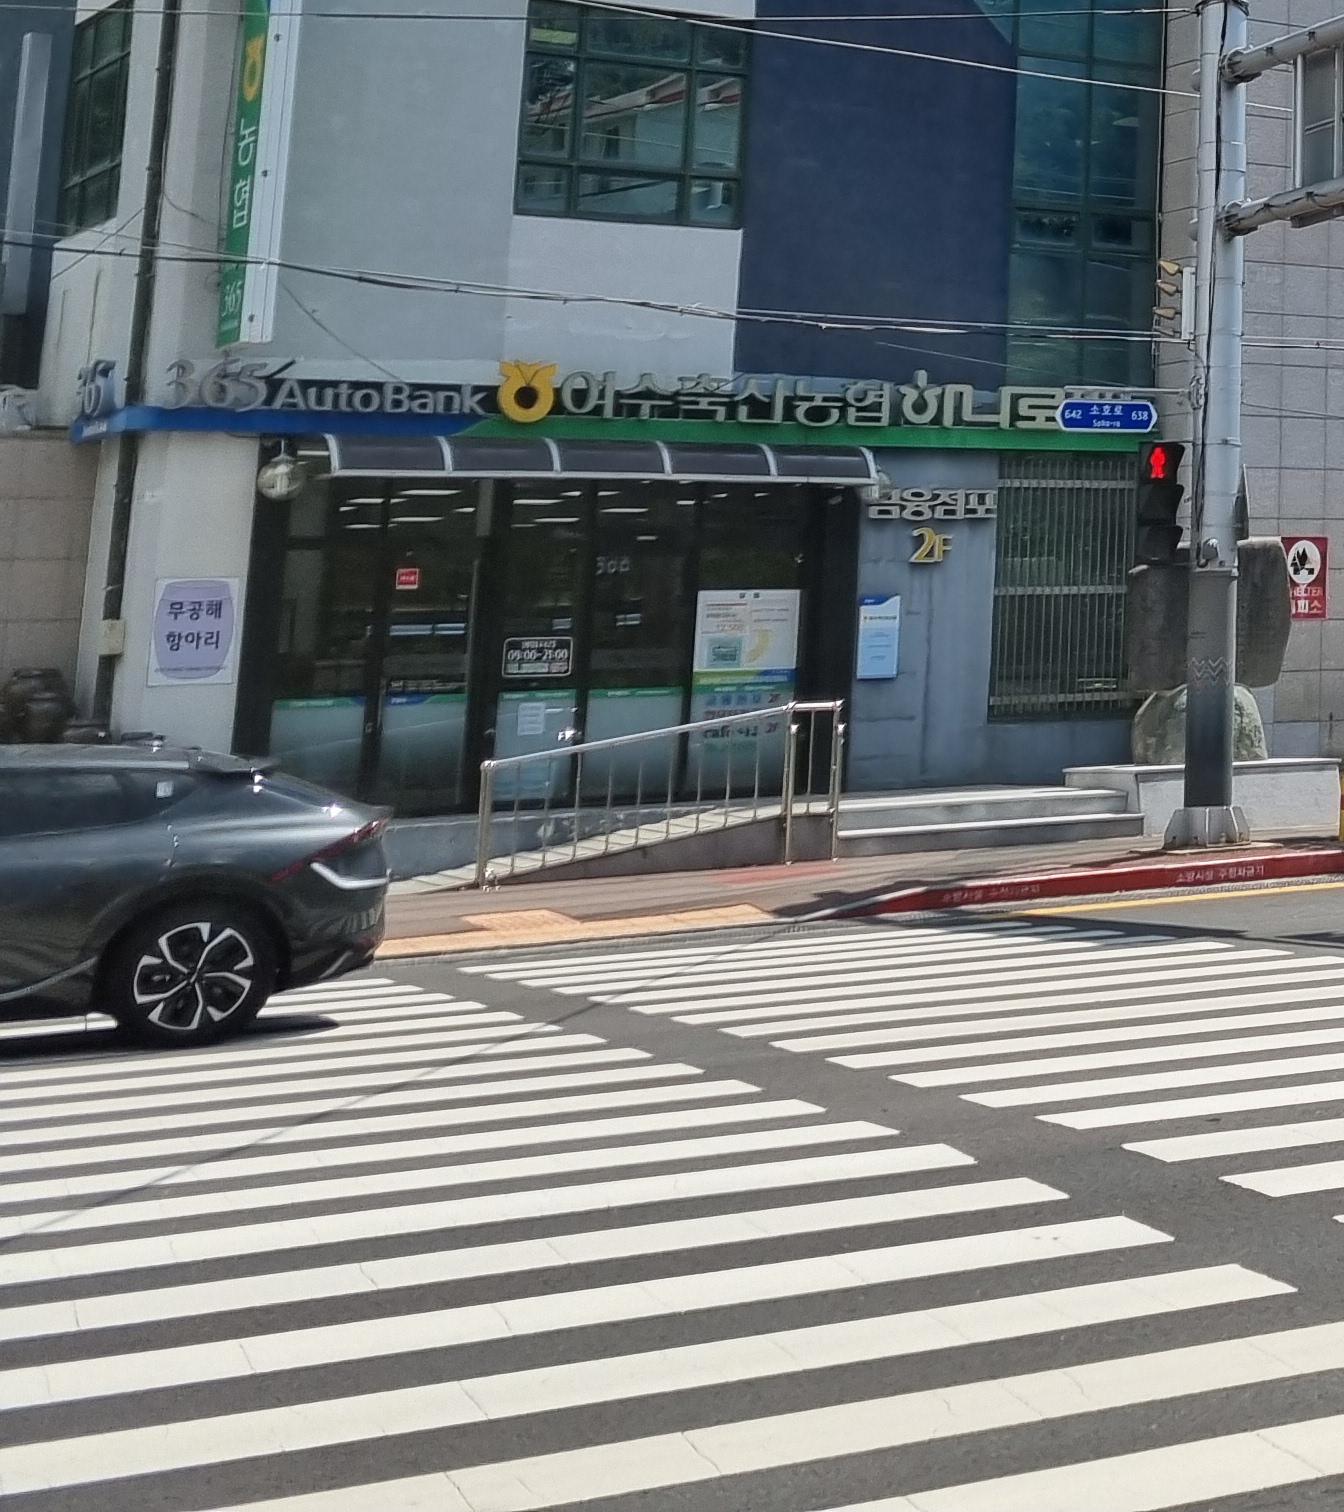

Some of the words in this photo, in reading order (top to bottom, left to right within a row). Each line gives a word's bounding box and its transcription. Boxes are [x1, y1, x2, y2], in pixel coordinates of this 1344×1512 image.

[232, 117, 258, 230] 농협
[164, 357, 268, 414] 365
[271, 377, 487, 419] AutoBank
[561, 370, 891, 428] 여수축산농협
[1064, 409, 1083, 420] 642
[1088, 404, 1125, 416] 소호로
[1130, 410, 1149, 421] 638
[909, 526, 955, 564] 2F
[168, 600, 223, 621] 무공해
[165, 630, 221, 652] 항아리
